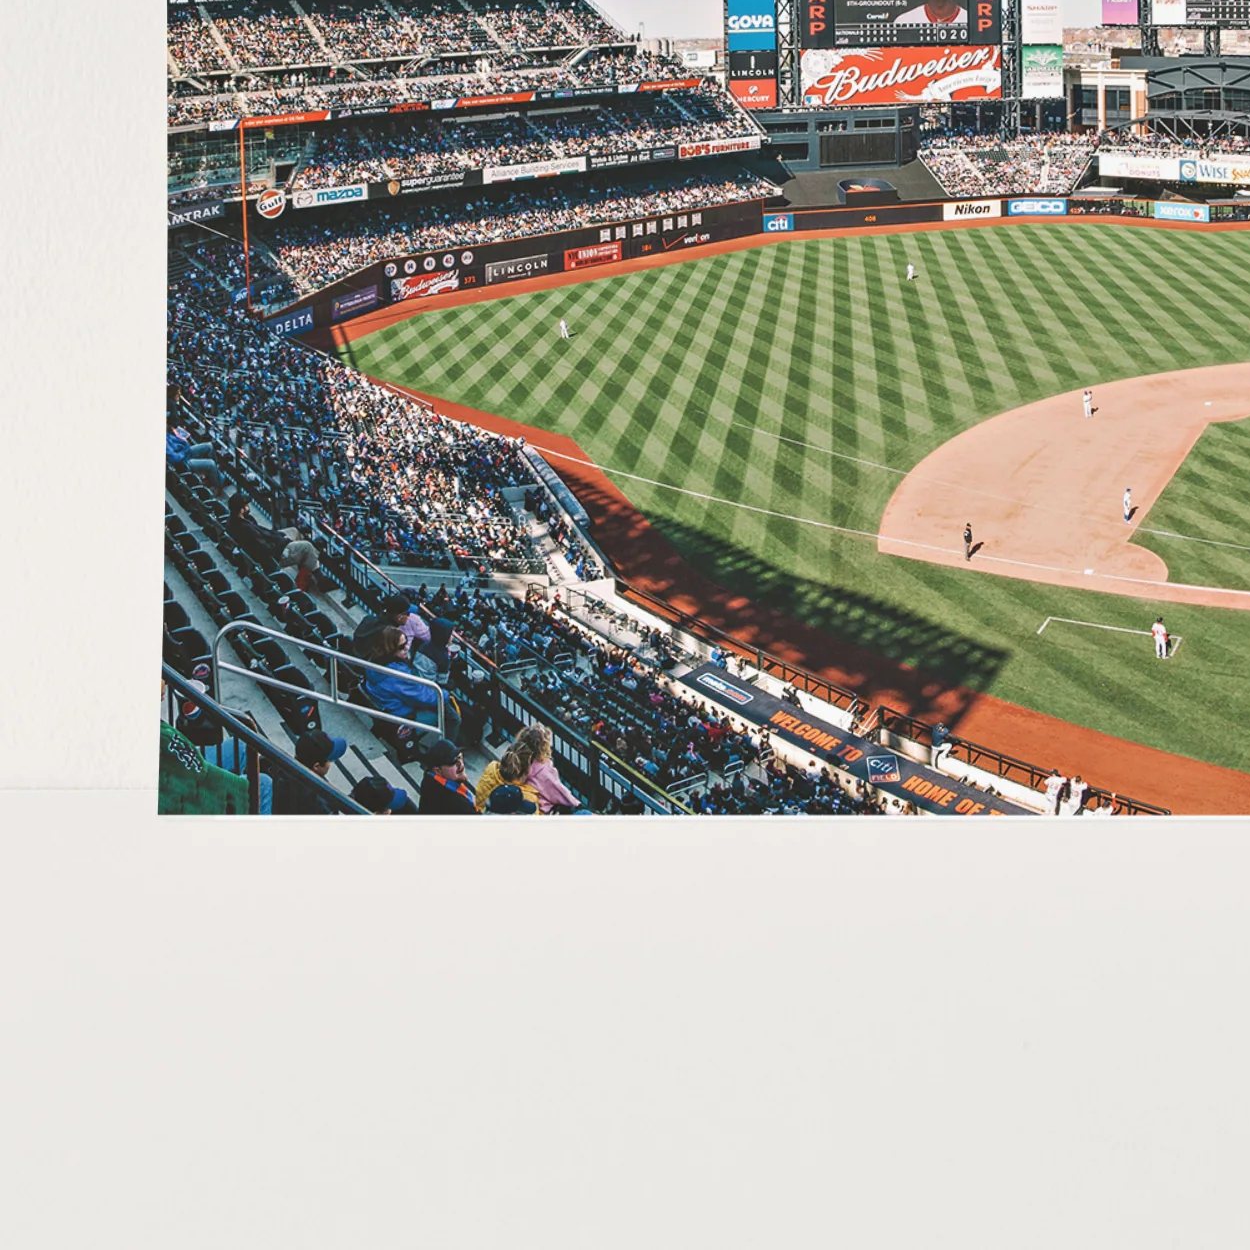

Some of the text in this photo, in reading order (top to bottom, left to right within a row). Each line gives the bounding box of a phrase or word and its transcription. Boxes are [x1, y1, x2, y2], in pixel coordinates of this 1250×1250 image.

[728, 14, 774, 30] GOYA
[940, 30, 947, 39] 0
[950, 30, 957, 39] 2
[960, 30, 968, 39] 0
[731, 69, 775, 77] LINCOLN
[813, 48, 990, 104] Budweiser
[737, 95, 770, 103] MERCURY
[680, 141, 749, 157] BOB'S FURNITURE
[491, 168, 519, 179] Alliance
[521, 165, 549, 176] Building
[551, 161, 580, 171] Services
[401, 172, 465, 188] superguarantee
[317, 187, 364, 202] mazda
[259, 195, 283, 212] Gulf
[954, 204, 990, 216] Nikon
[1010, 201, 1064, 213] GEICO
[167, 206, 220, 226] AMTRAK
[1160, 207, 1192, 218] xerox
[768, 217, 788, 231] citi
[684, 233, 710, 244] verizon
[493, 260, 548, 277] LINCOLN
[402, 271, 458, 298] Budweiser
[464, 276, 476, 284] 371
[276, 313, 313, 335] DELTA
[769, 710, 864, 762] WELCOME TO
[869, 758, 893, 773] citi
[901, 775, 986, 816] HOME OF
